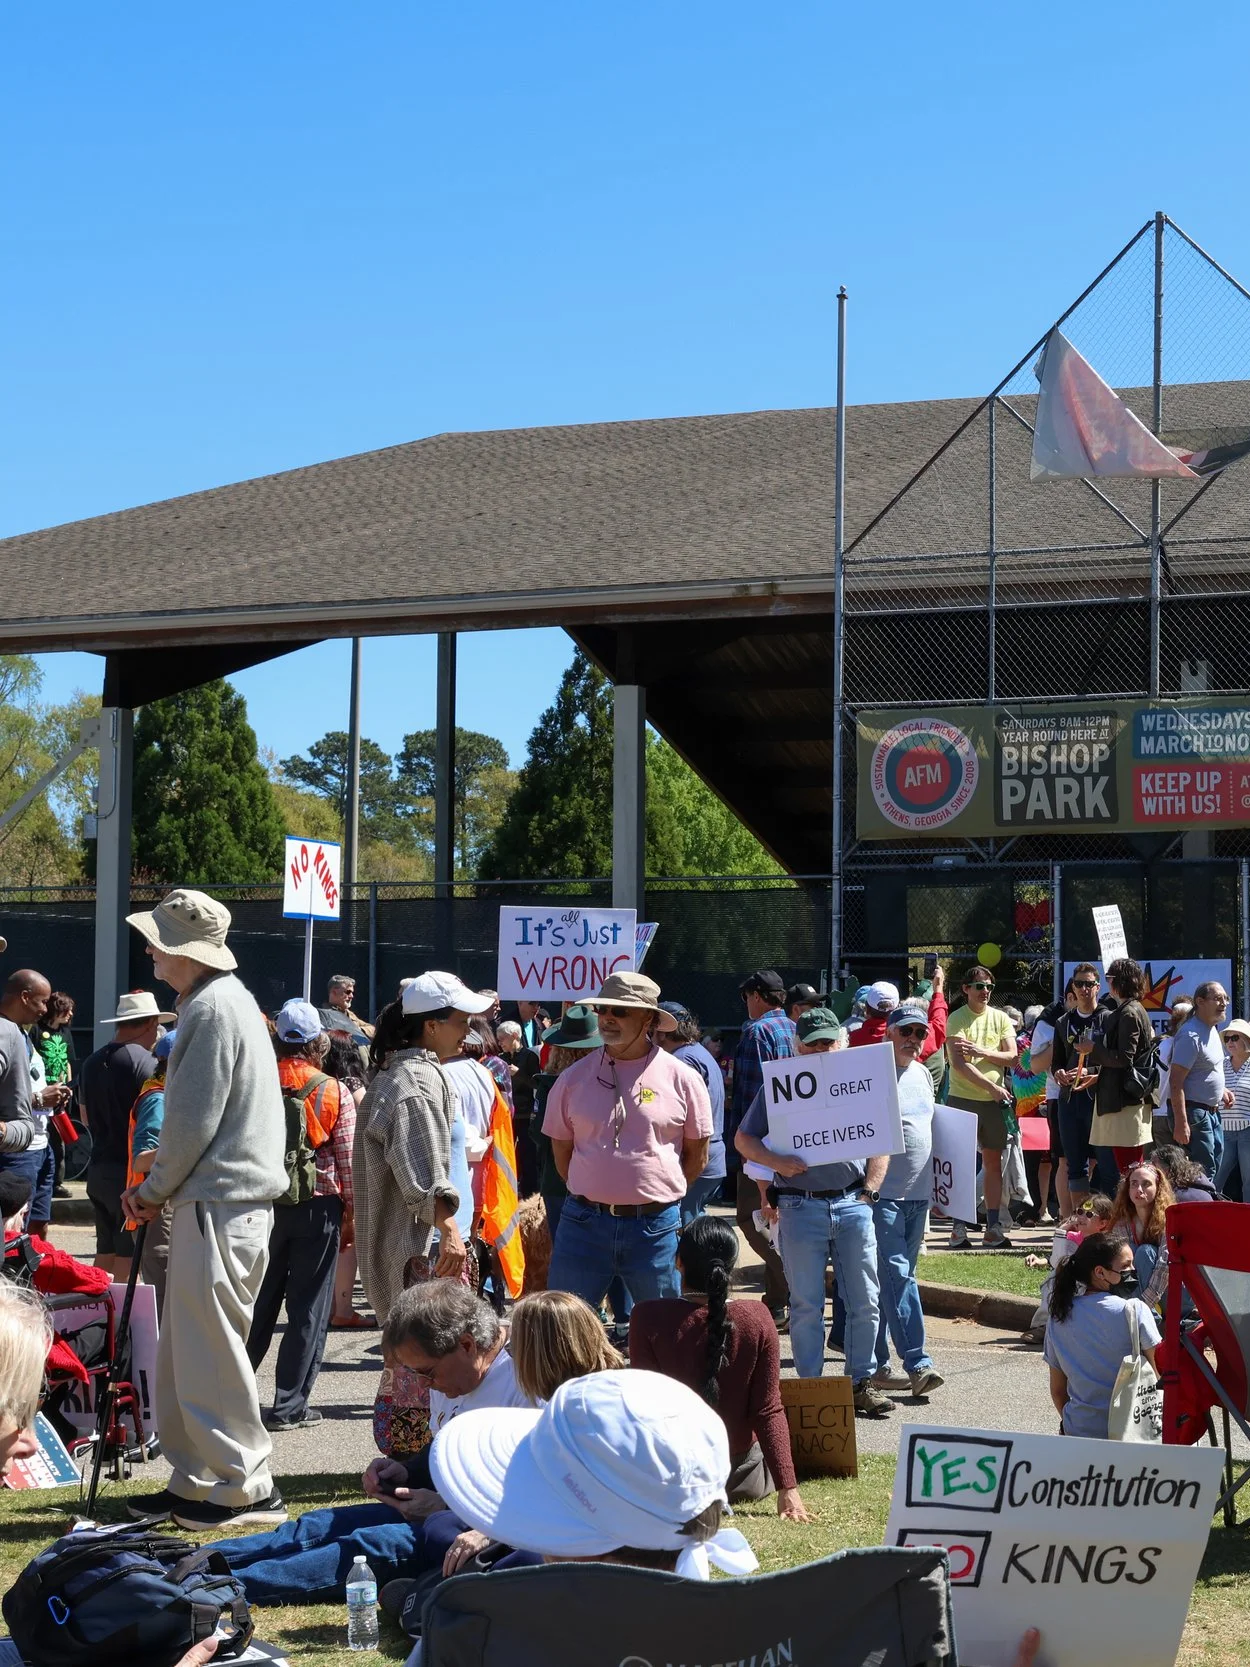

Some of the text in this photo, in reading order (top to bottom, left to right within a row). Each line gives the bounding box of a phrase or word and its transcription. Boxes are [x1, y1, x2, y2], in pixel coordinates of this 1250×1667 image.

[1002, 715, 1110, 730] SATURDAYS 8AM-12PM
[1002, 728, 1109, 743] YEAR ROUND HERE AT
[1140, 734, 1204, 754] MARCH
[1206, 734, 1224, 749] TO
[1001, 743, 1110, 776] BISHOP
[904, 763, 942, 788] AFM
[1141, 771, 1222, 794] KEEP UP
[914, 809, 952, 826] GEORGIA
[951, 788, 970, 811] SINCE
[965, 760, 974, 785] 2008
[1001, 776, 1111, 820] PARK
[1142, 795, 1221, 816] WITH US!
[291, 844, 338, 909] NO KINGS
[515, 910, 622, 947] It's all Just
[771, 1071, 873, 1104] NO GREAT
[781, 1380, 843, 1390] OULDN'T
[784, 1404, 854, 1430] TECT
[916, 1446, 1200, 1509] YES Constitution
[905, 1543, 1162, 1584] O KINGS
